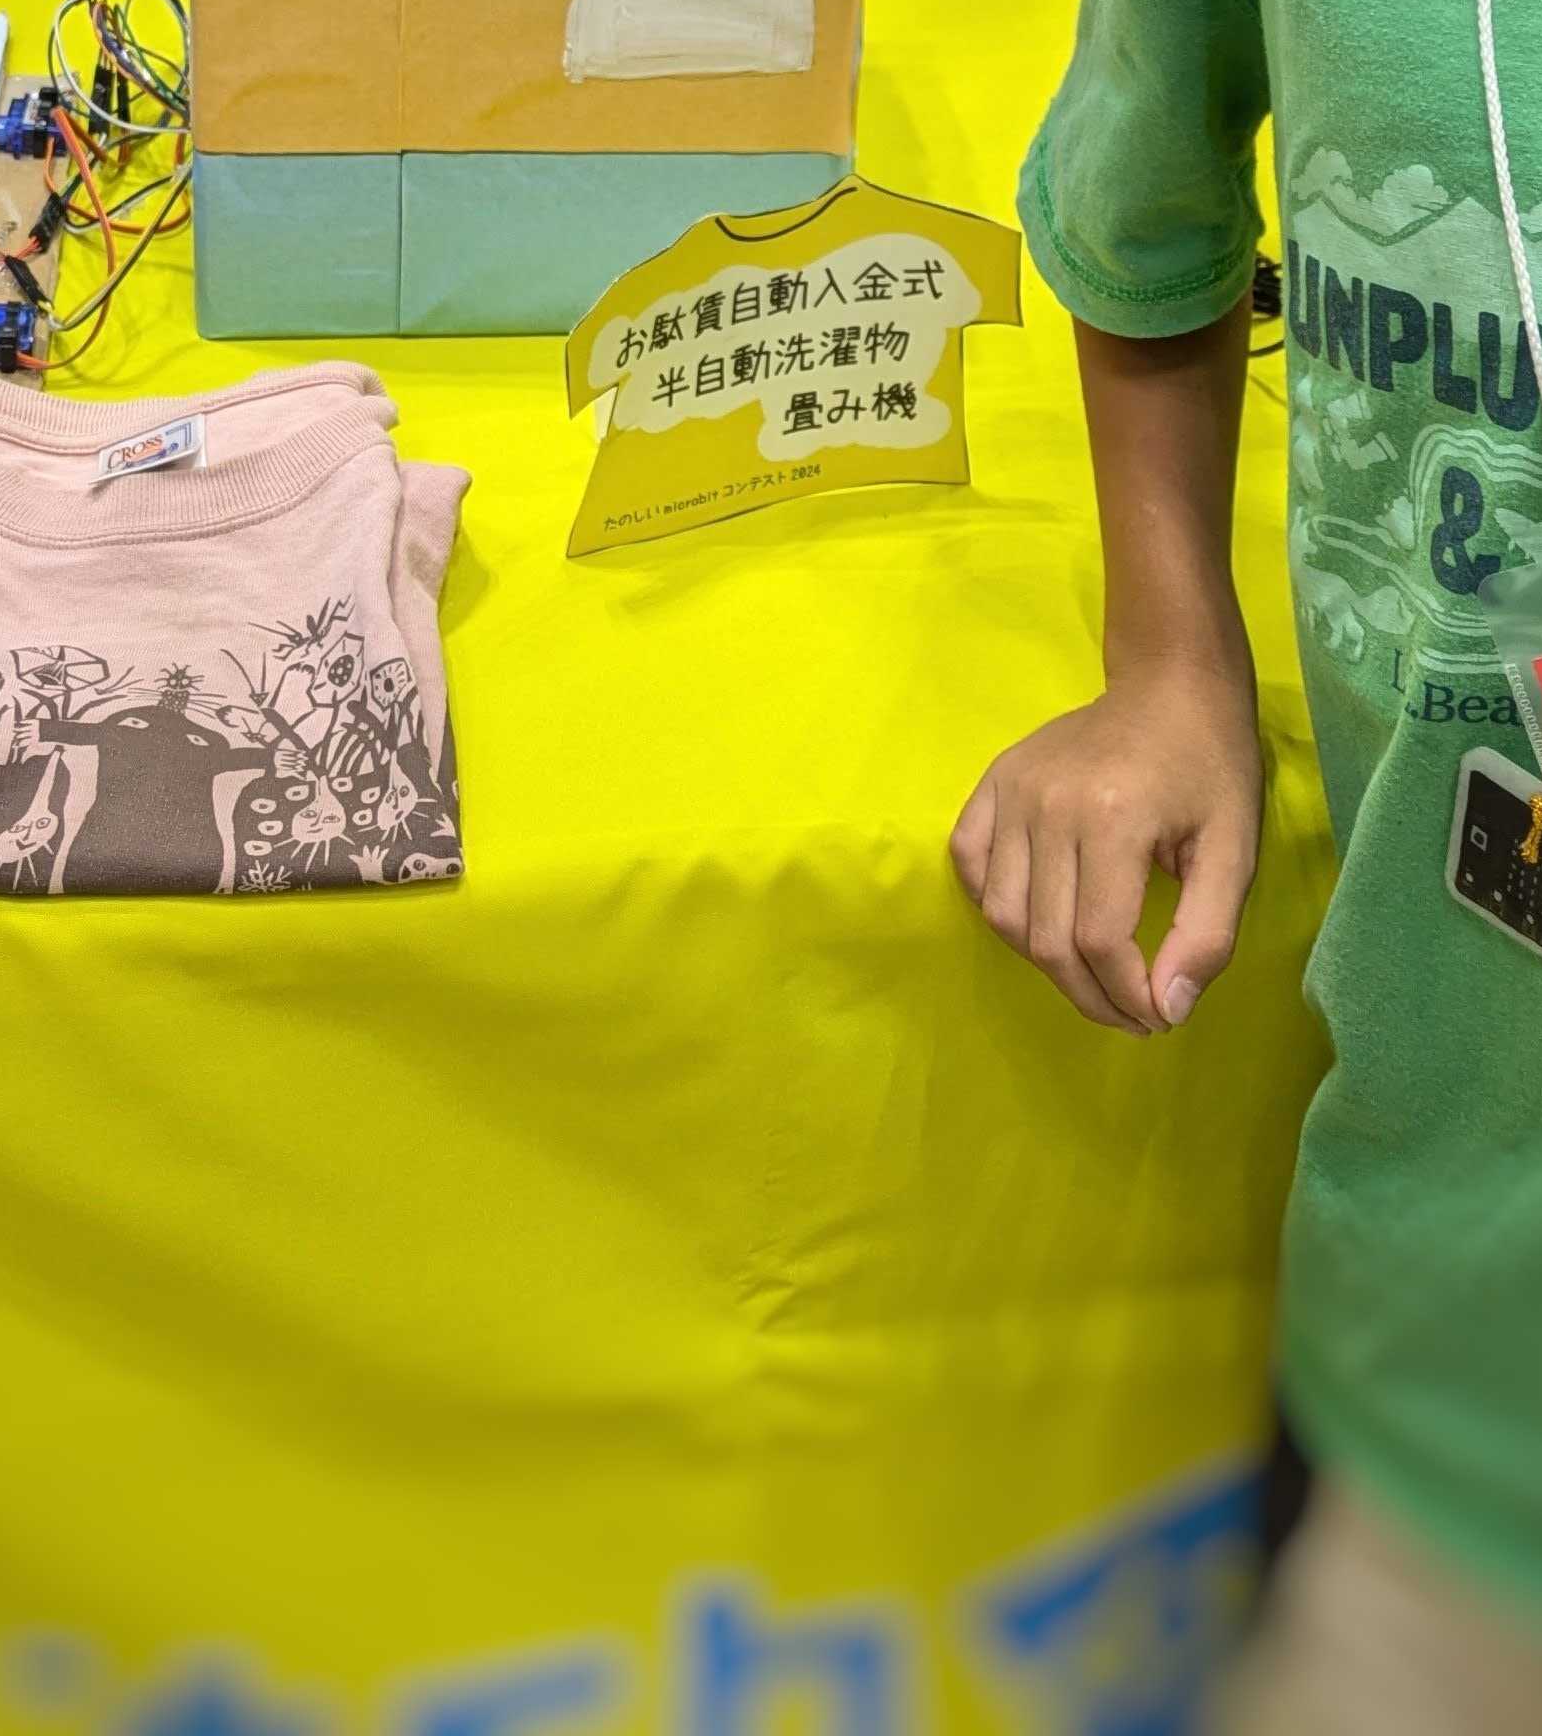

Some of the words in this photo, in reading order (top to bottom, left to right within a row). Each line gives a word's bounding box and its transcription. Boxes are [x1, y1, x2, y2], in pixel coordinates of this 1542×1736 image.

[616, 260, 946, 368] お駄賃自動入金式
[651, 321, 911, 408] 半自動洗濯物
[781, 381, 919, 437] 畳み機
